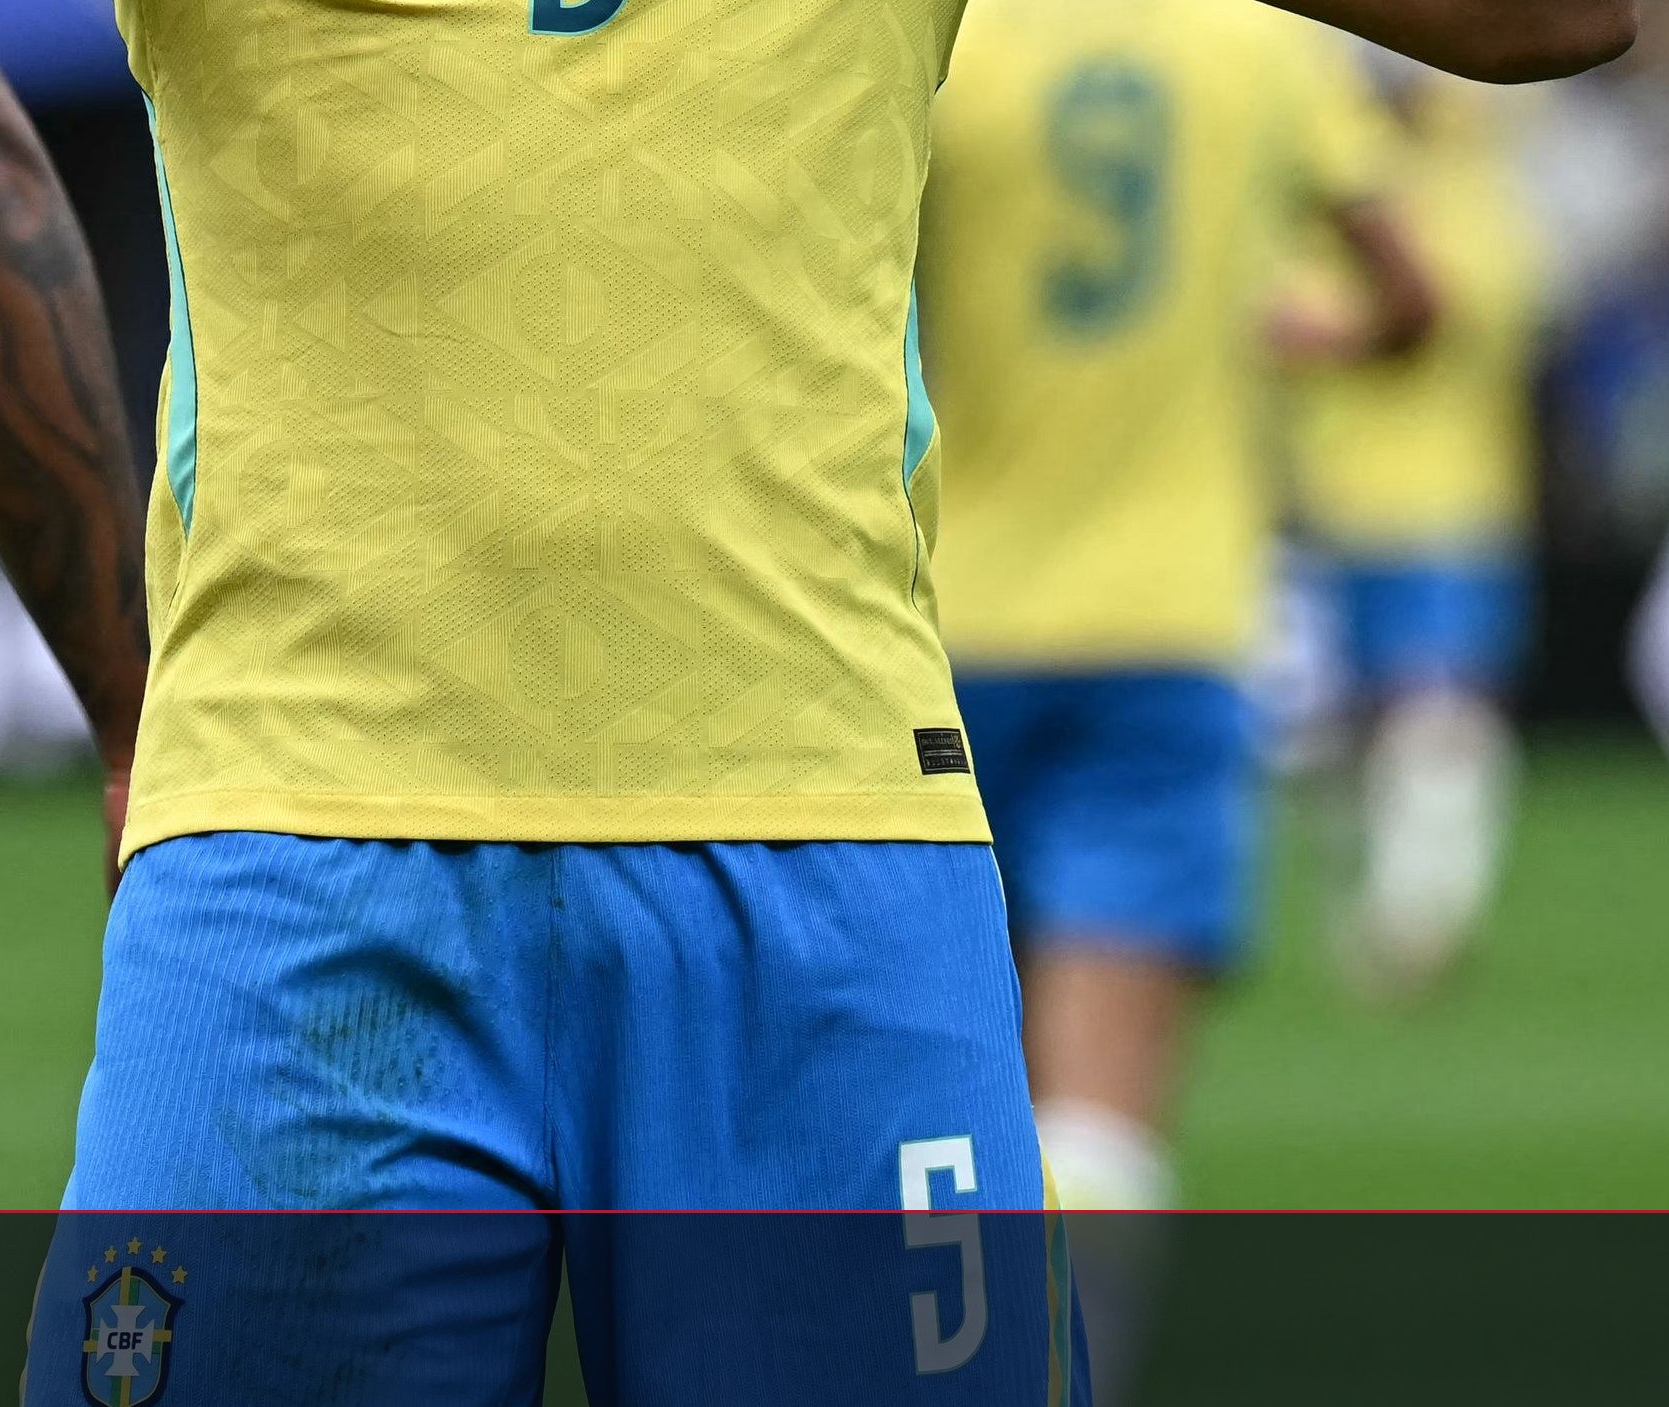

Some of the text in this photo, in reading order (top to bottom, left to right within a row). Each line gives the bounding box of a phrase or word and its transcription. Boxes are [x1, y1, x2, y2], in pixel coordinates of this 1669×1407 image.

[1038, 54, 1174, 342] 9
[106, 1332, 144, 1350] CBF
[899, 1134, 988, 1376] 5
